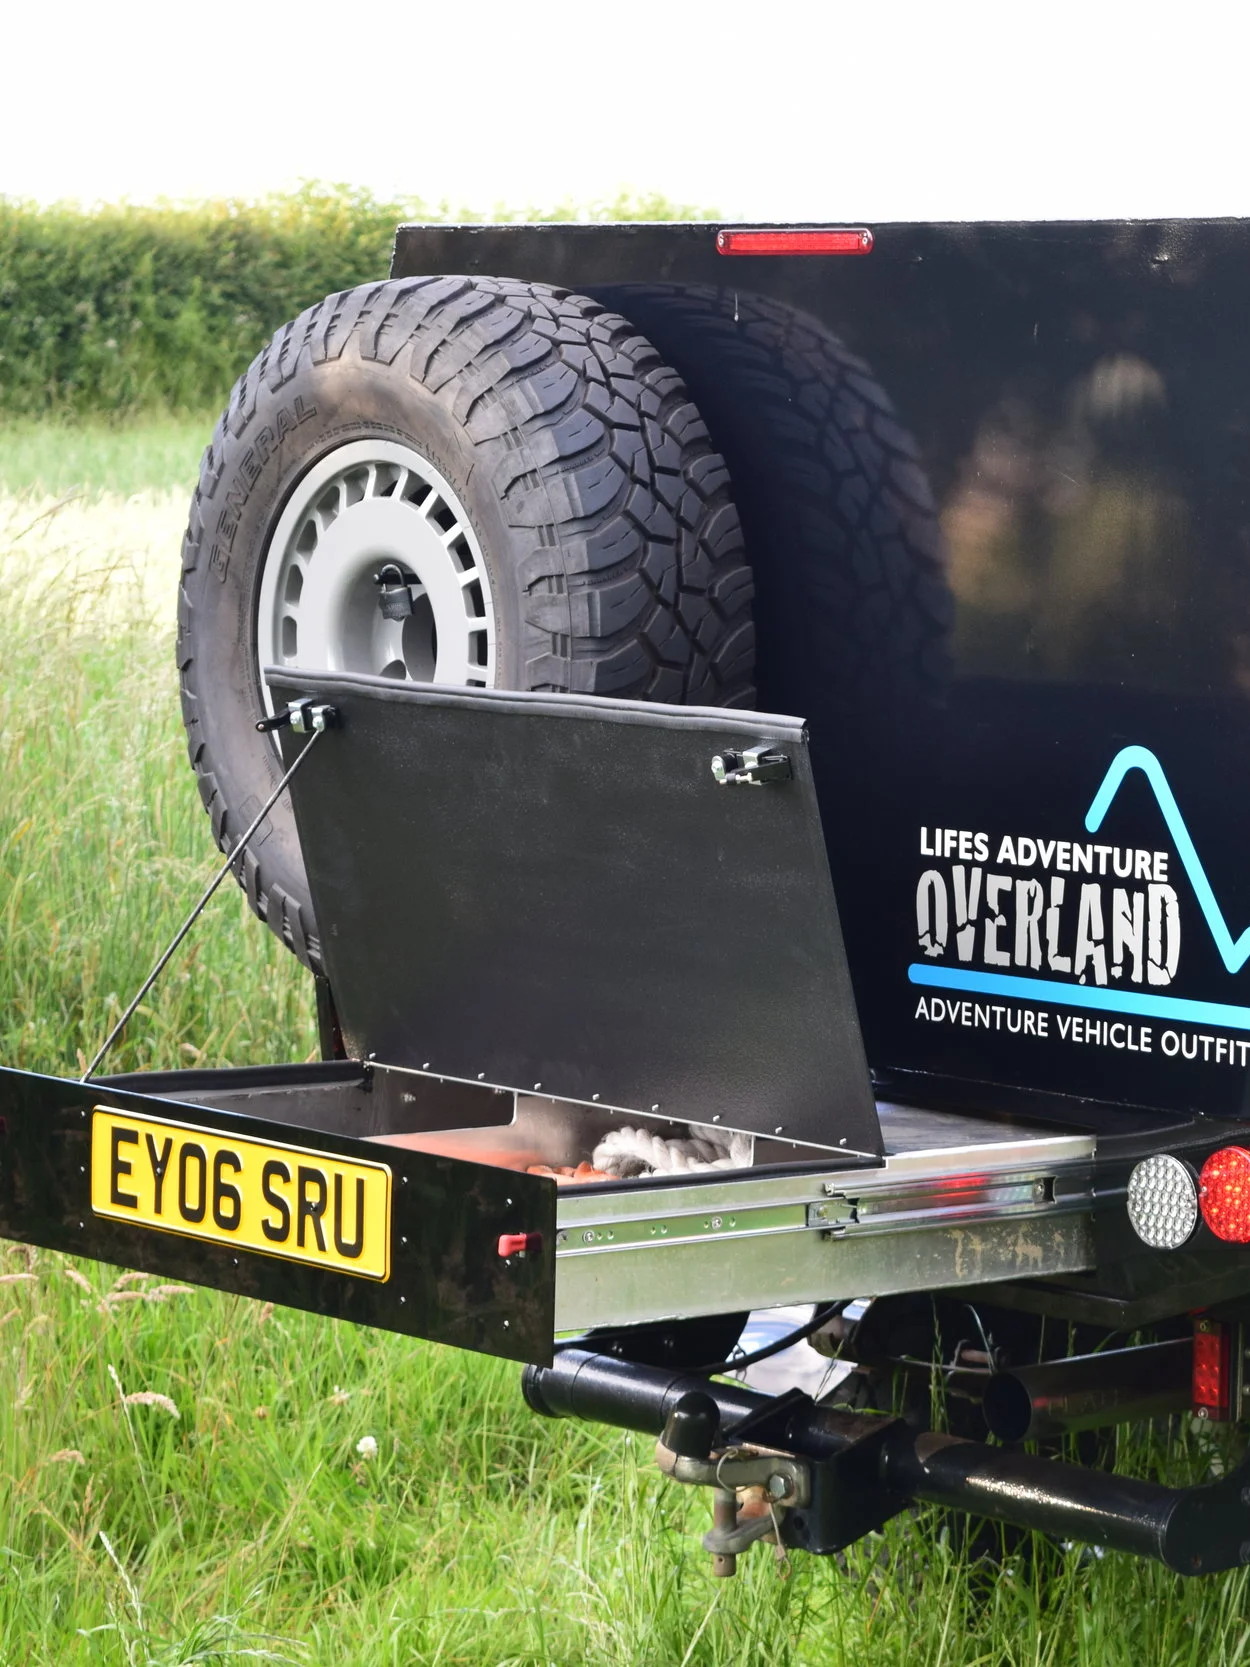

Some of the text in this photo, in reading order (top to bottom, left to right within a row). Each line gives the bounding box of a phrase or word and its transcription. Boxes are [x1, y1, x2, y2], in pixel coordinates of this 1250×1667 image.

[208, 395, 318, 585] GENERAL
[920, 826, 1169, 881] LIFES ADVENTURE
[916, 865, 1181, 986] OVERLAND
[915, 997, 1048, 1038] ADVENTURE
[1057, 1015, 1152, 1053] VEHICLE
[111, 1126, 365, 1259] EY06 SRU
